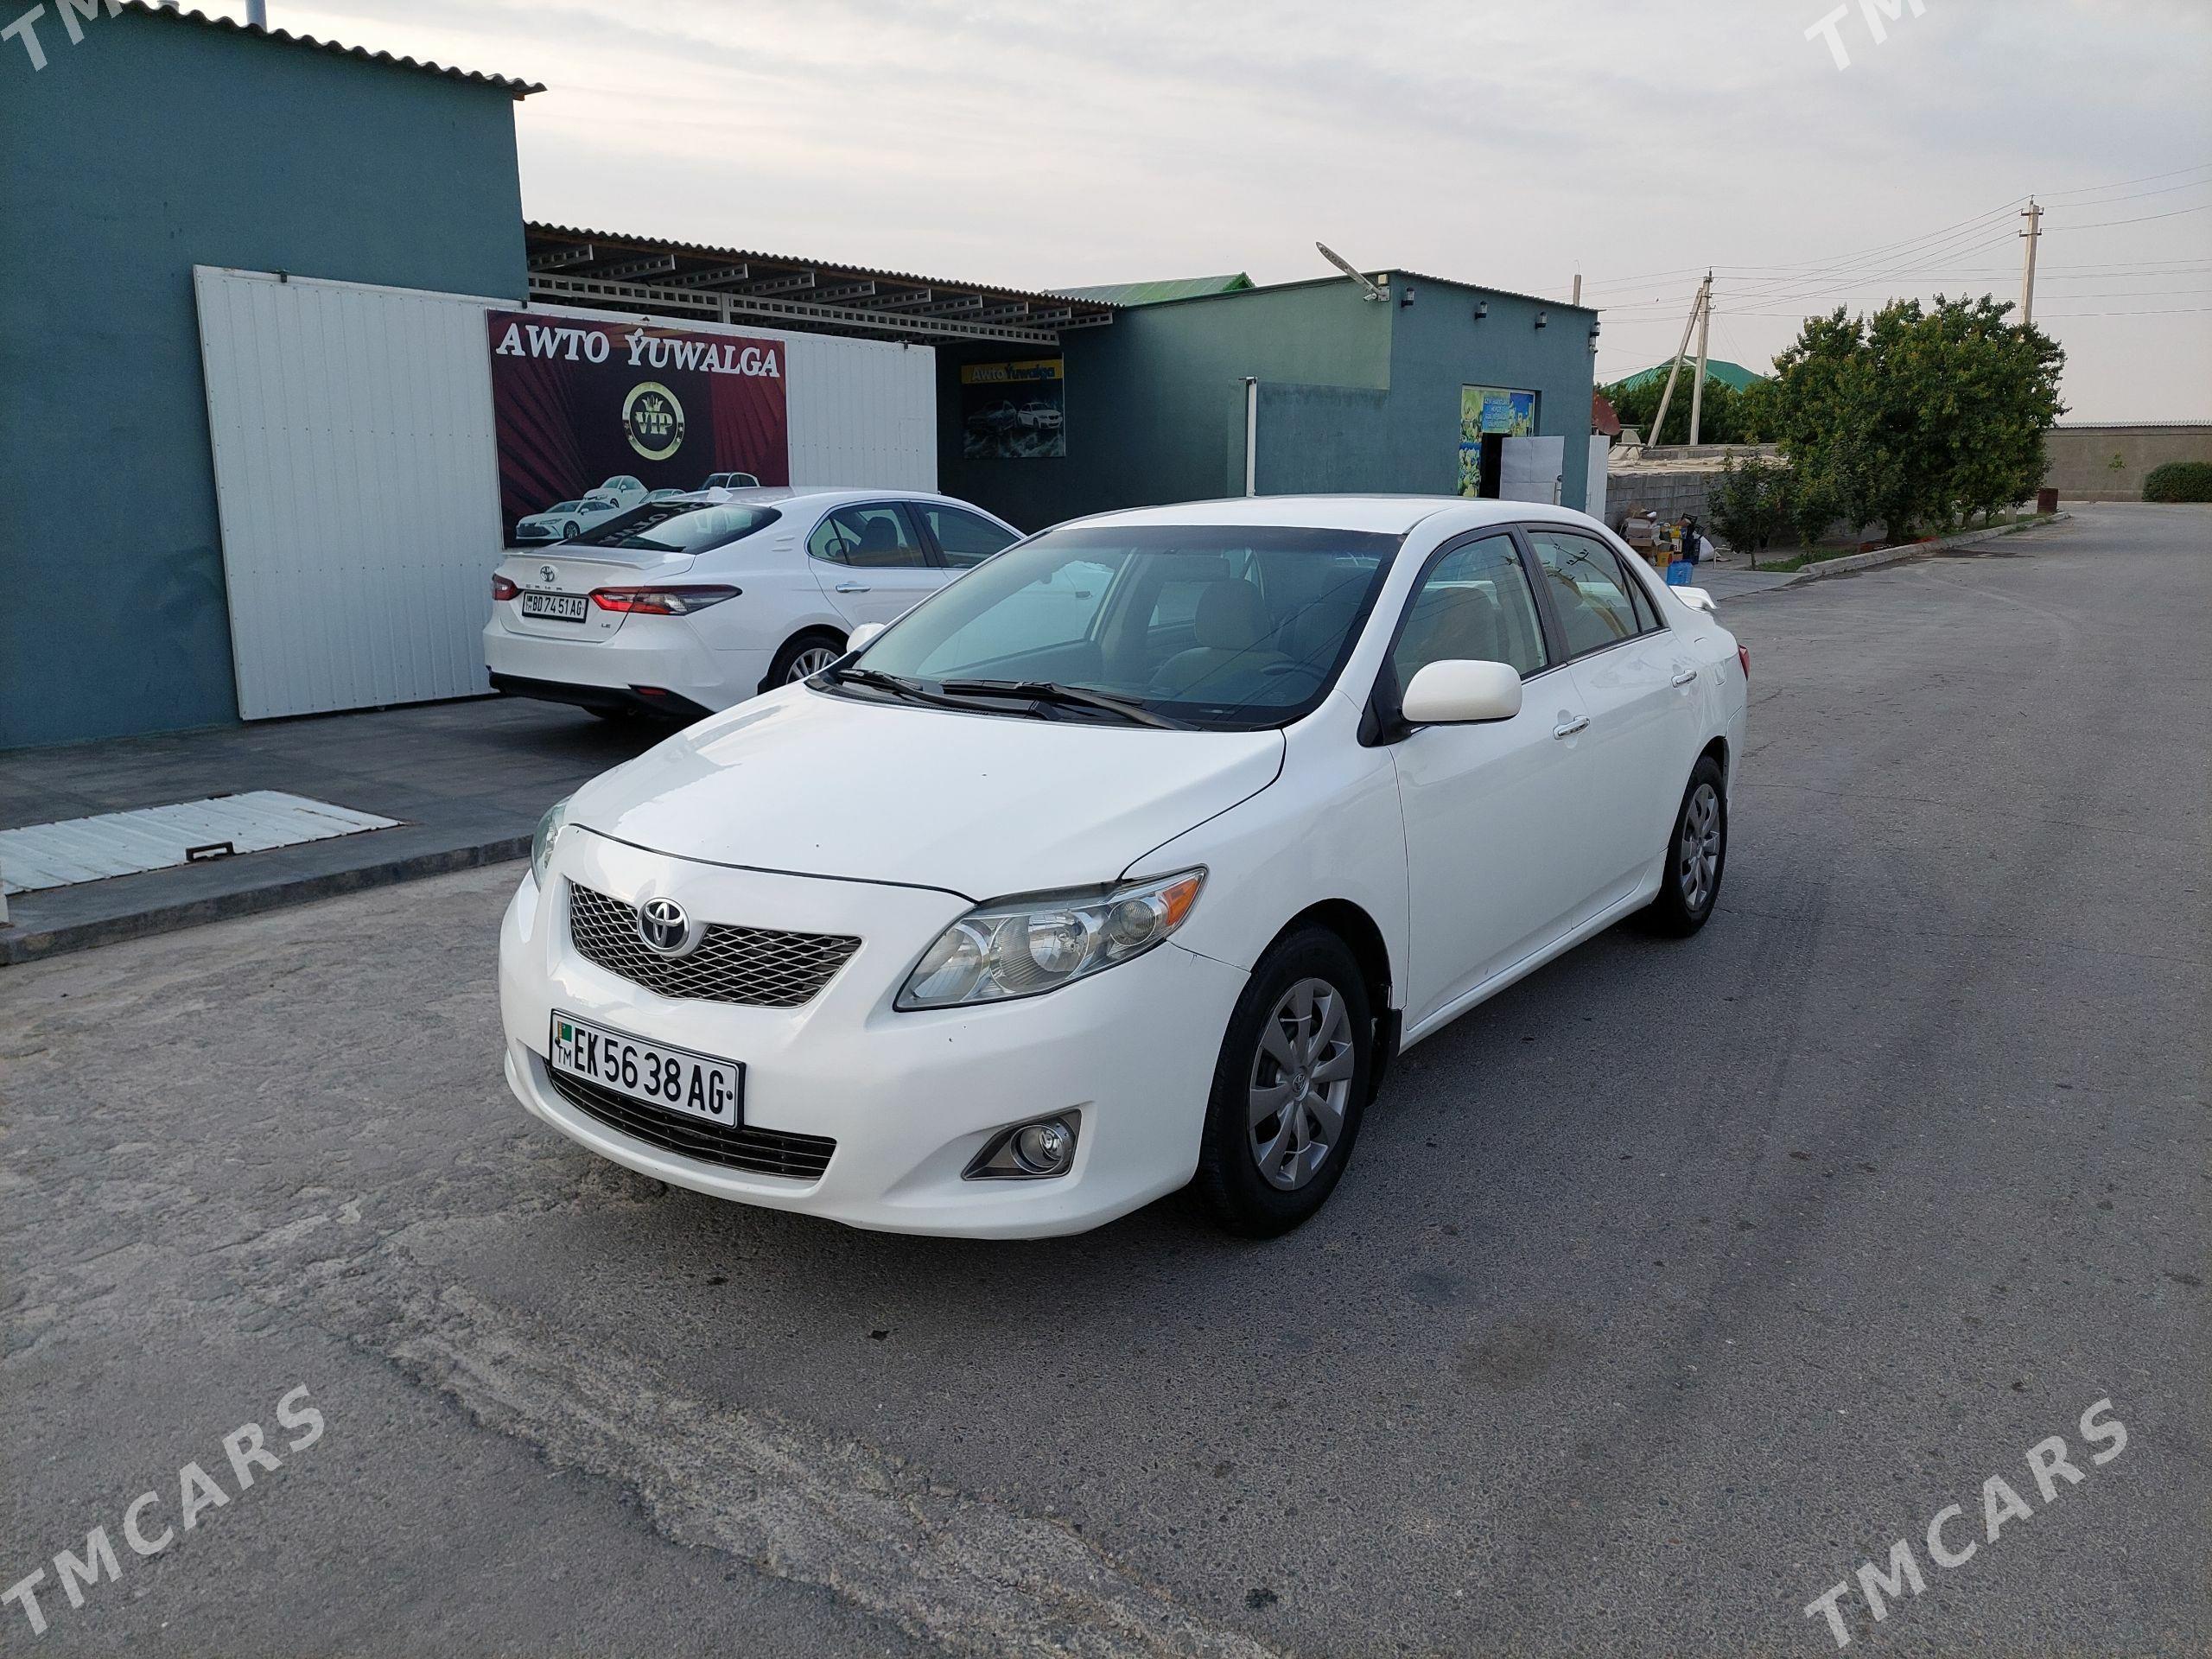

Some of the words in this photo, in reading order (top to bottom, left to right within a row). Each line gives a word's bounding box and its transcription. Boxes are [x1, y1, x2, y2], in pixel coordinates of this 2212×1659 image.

[495, 322, 610, 363] AWTO
[624, 327, 779, 378] ÝUWALGA
[635, 411, 673, 435] VIP
